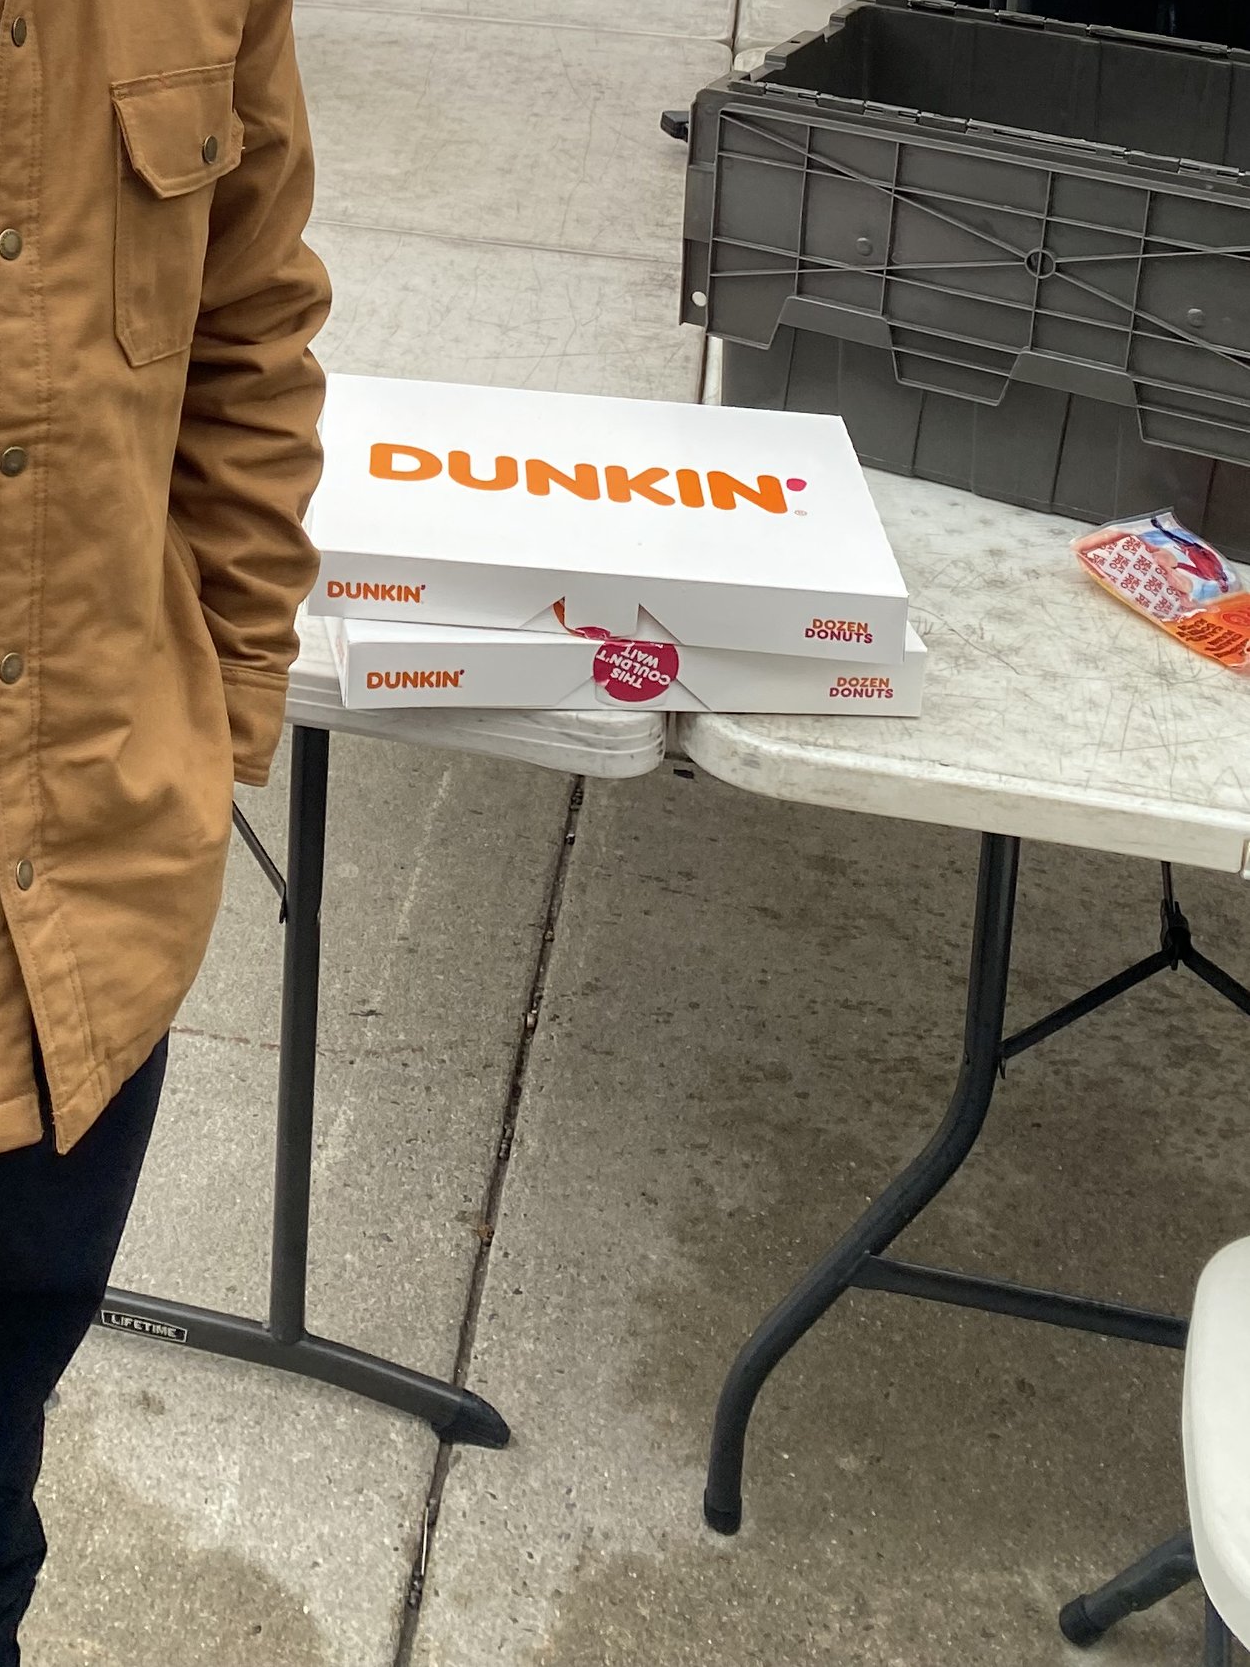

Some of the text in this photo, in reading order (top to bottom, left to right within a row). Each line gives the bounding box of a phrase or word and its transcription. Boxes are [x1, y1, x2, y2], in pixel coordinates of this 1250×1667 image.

[369, 442, 807, 515] DUNKIN'
[327, 581, 426, 603] DUNKIN'
[804, 628, 873, 644] DONUTS
[812, 618, 869, 634] DOZEN
[595, 649, 671, 686] COULDN'T
[621, 646, 659, 669] WAIT
[366, 669, 465, 689] DUNKIN'
[610, 669, 643, 689] THIS
[836, 677, 890, 688] DOZEN
[829, 687, 894, 699] DONUTS
[111, 1314, 177, 1338] LIFETIME
